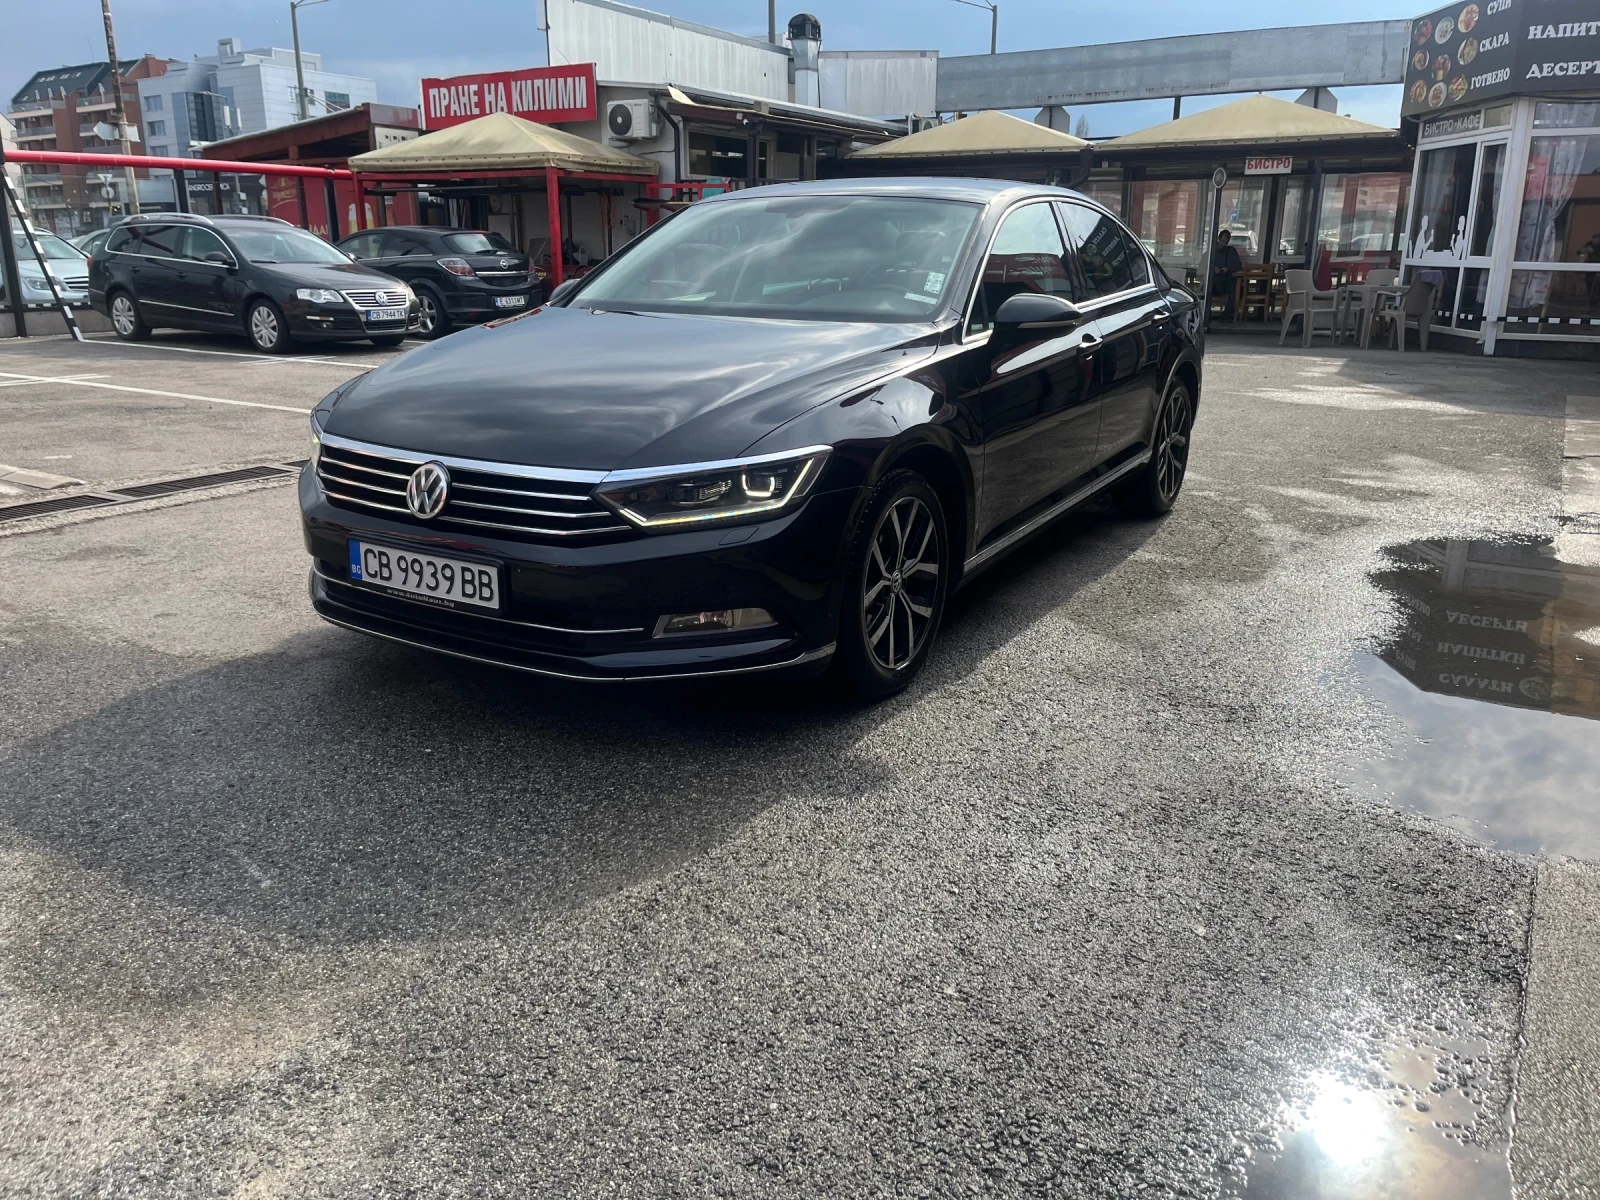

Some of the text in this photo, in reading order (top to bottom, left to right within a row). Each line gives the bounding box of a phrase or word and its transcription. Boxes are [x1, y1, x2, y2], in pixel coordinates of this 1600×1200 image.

[1479, 32, 1510, 53] СКАРА
[1470, 67, 1511, 90] ГОТВЕНО
[428, 75, 587, 118] ПРАНЕ НА КИЛИМИ
[1246, 156, 1291, 170] БИСТРО
[372, 310, 404, 320] CB 7944 TK
[351, 563, 362, 574] BG
[363, 547, 494, 602] CB 9939 BB
